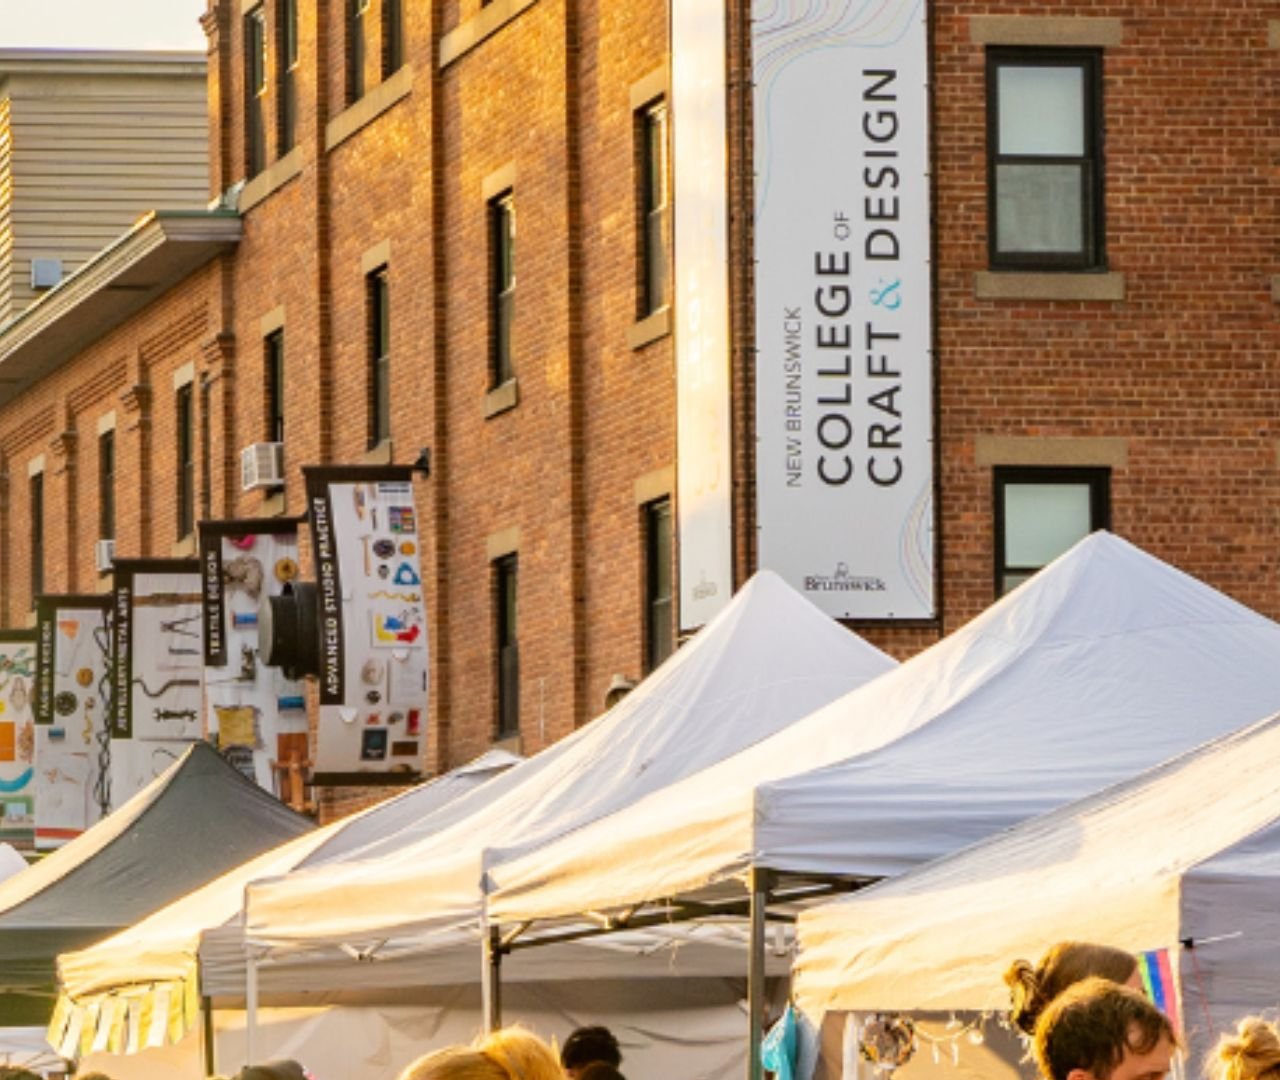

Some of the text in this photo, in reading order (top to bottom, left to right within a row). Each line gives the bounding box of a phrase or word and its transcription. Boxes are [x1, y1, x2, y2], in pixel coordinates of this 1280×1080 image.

[815, 211, 853, 487] COLLEGE OF
[862, 68, 903, 487] CRAFT & DESIGN
[783, 306, 803, 488] NEW BRUNSWICK
[206, 550, 220, 656] TEXTILE DESIGN
[313, 496, 340, 695] ADVANCED STUDIO PRACTICE
